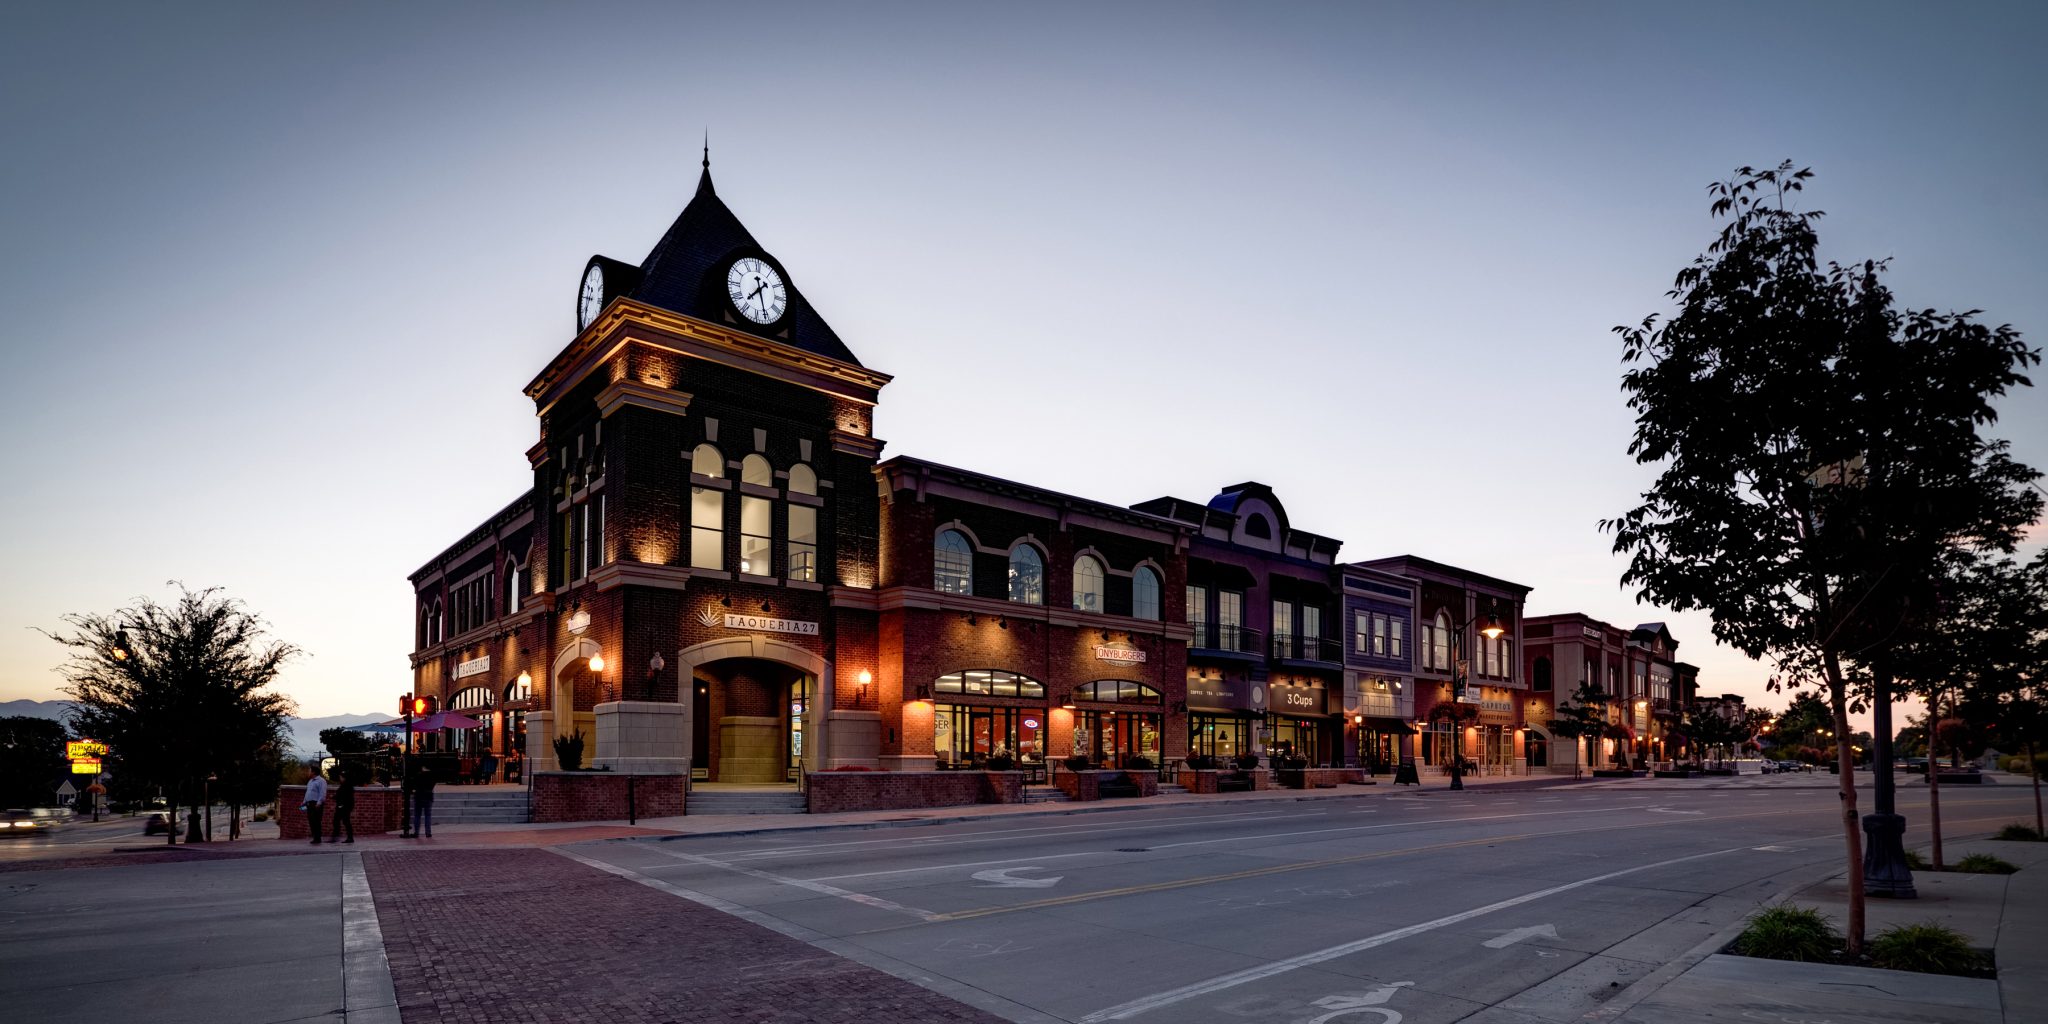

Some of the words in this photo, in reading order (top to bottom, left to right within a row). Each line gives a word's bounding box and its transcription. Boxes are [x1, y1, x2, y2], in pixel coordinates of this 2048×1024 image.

[729, 616, 815, 632] TAQUERIA27
[1093, 645, 1145, 661] TONYBURGERS
[1287, 693, 1293, 704] 3
[1293, 693, 1313, 708] Cups
